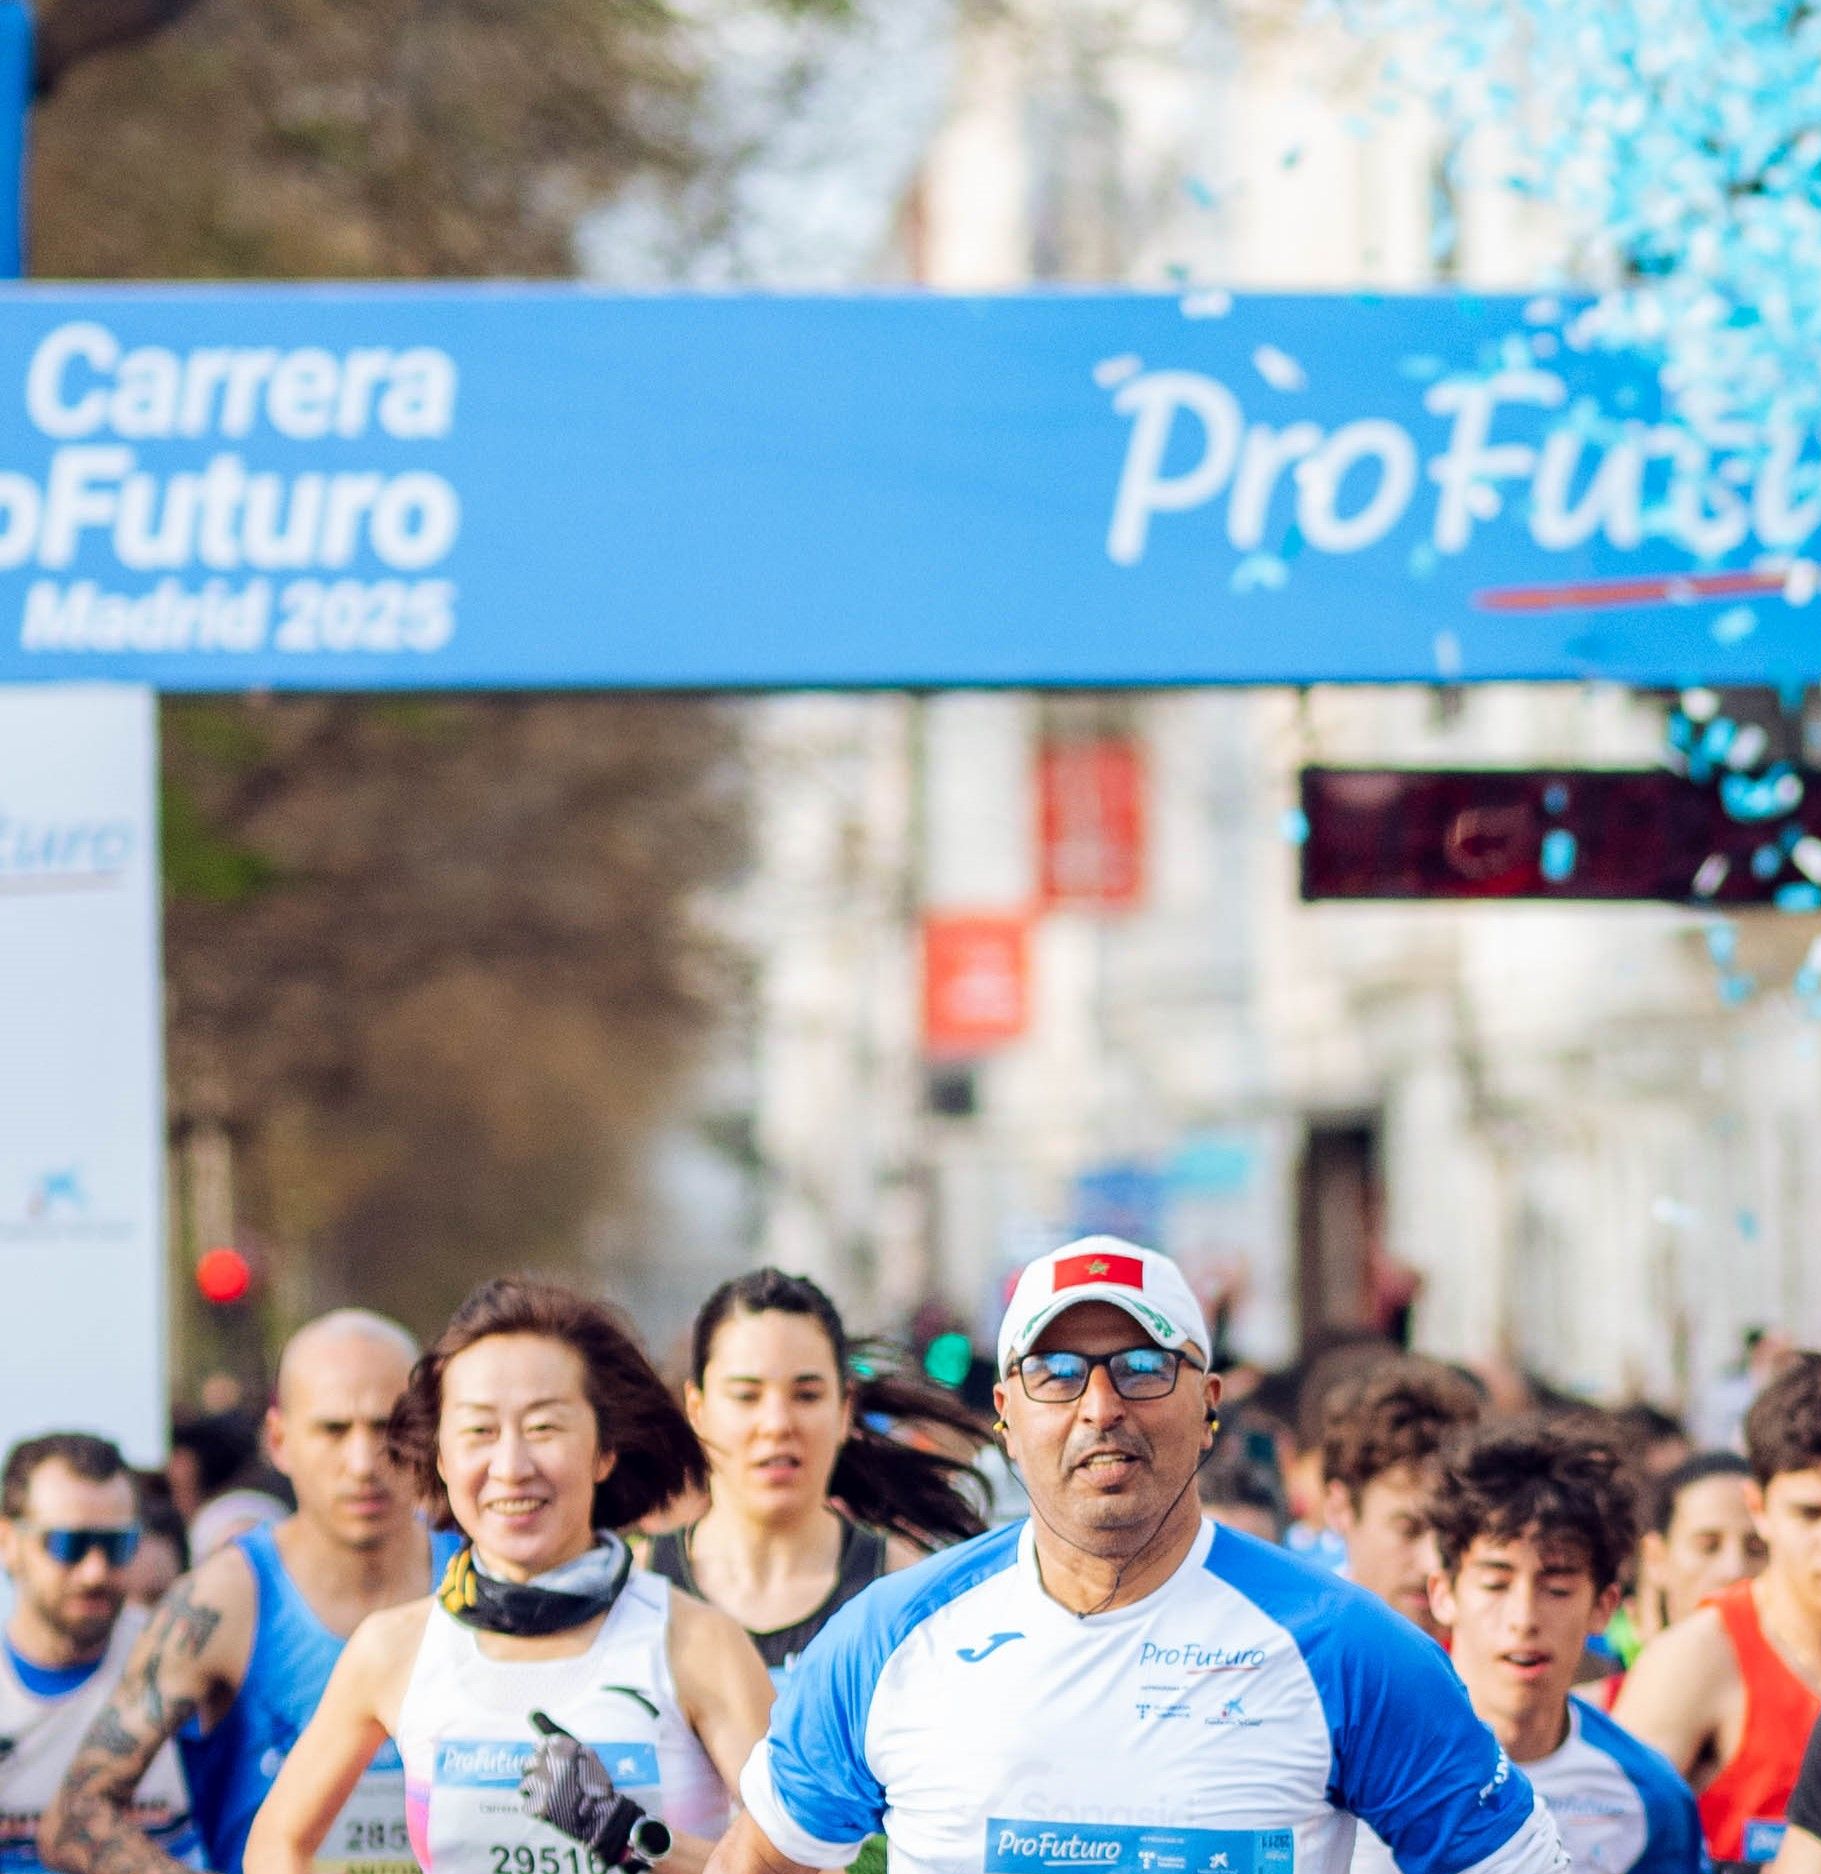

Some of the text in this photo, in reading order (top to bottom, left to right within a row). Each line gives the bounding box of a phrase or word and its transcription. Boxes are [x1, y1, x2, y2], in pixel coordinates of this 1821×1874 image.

[27, 320, 457, 440] Carrera
[21, 578, 457, 652] Madrid 2025
[0, 813, 137, 874] uro
[1139, 1642, 1266, 1667] ProFuturo
[443, 1745, 525, 1775] ProFutu
[998, 1829, 1122, 1861] ProFuturo
